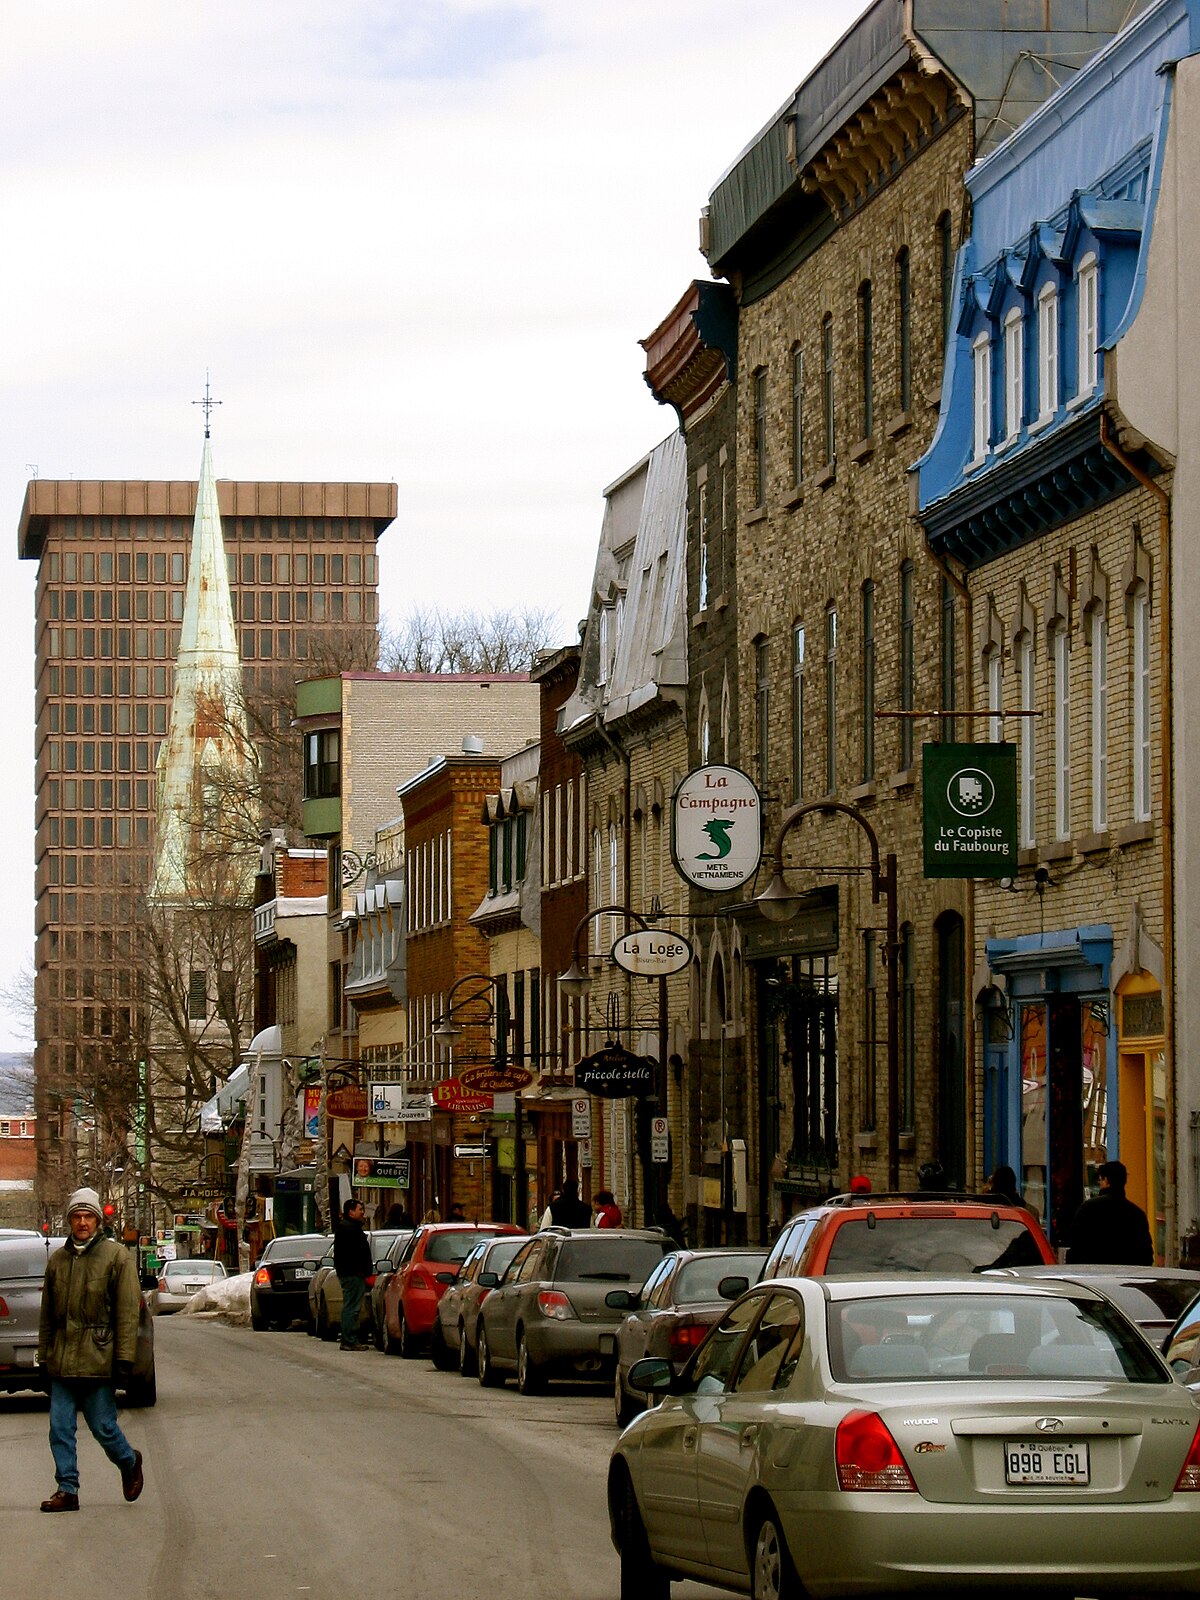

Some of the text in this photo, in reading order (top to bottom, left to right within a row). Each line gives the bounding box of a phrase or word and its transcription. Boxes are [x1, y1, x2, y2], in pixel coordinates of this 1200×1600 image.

[705, 774, 728, 788] La
[679, 796, 757, 813] Campagne
[940, 826, 1003, 840] Le Copiste
[934, 840, 1010, 855] du Faubourg
[691, 871, 744, 879] VIETNAMIENS
[623, 942, 684, 958] La Loge
[583, 1067, 650, 1082] piccole stelle
[903, 1418, 939, 1426] HYUNDAI
[1151, 1417, 1190, 1426] ELANTRA
[1009, 1453, 1086, 1474] 898 EGL
